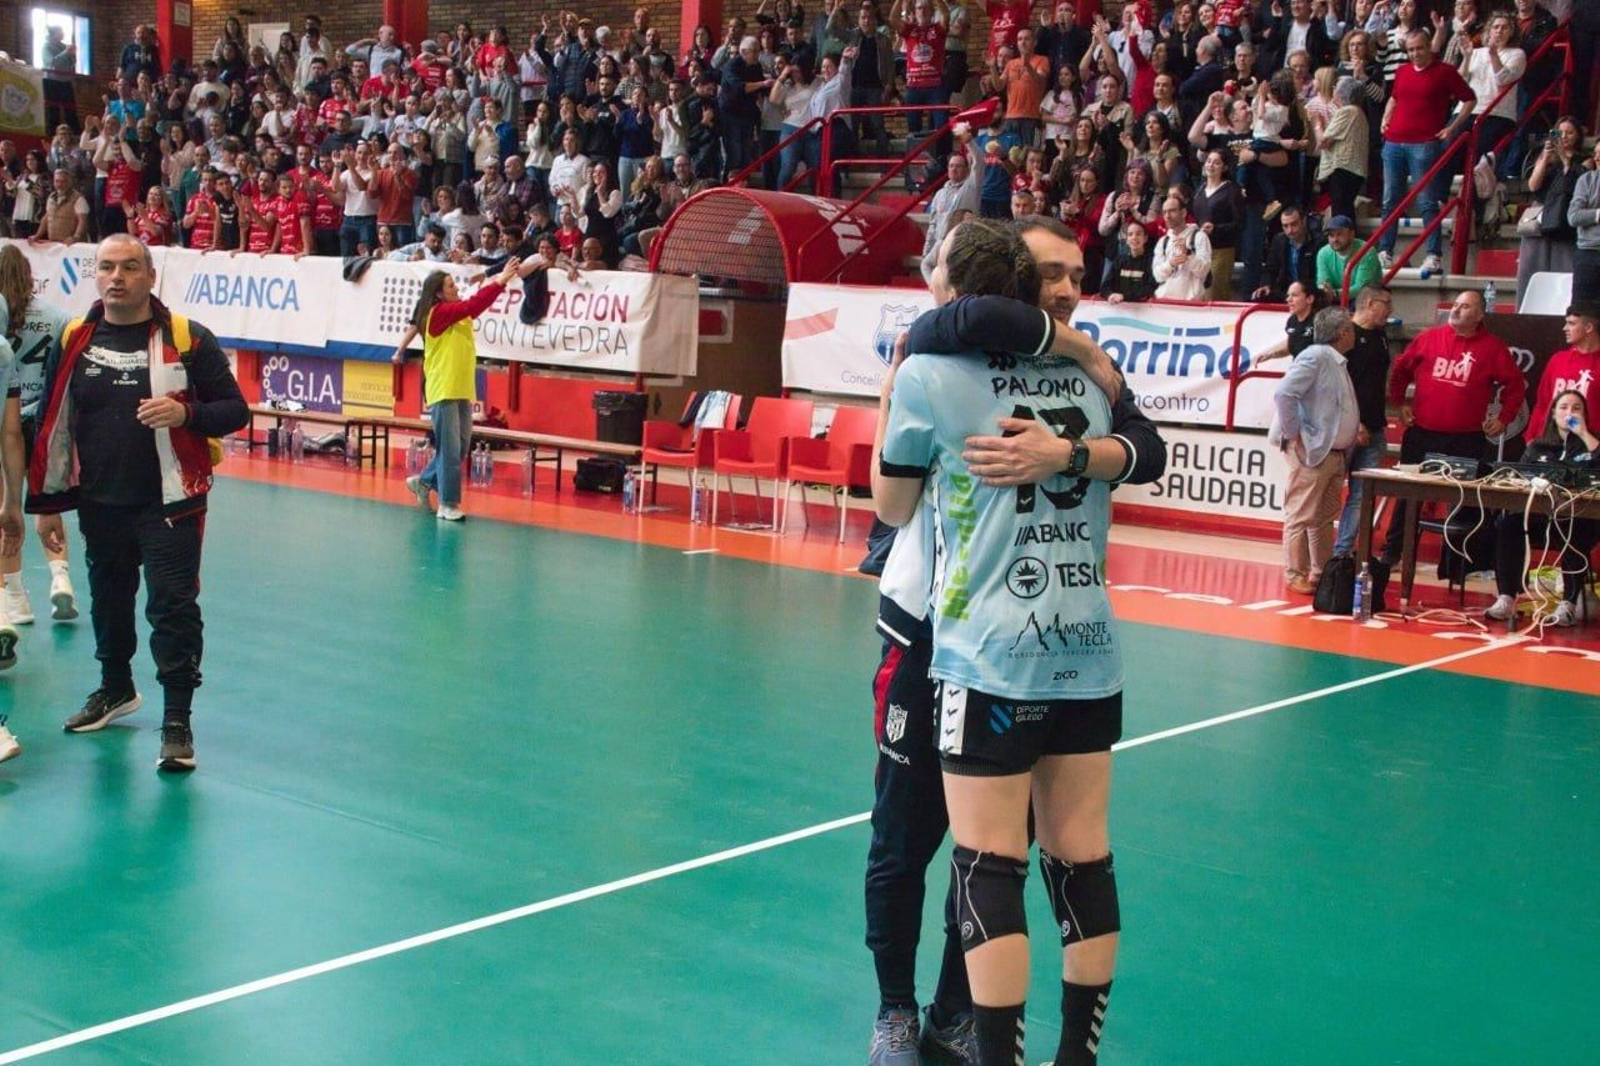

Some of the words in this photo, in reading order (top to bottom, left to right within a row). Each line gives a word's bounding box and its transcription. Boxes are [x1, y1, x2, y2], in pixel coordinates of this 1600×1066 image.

[287, 369, 341, 405] G.I.A.
[991, 376, 1085, 399] PALOMO
[1163, 441, 1265, 476] ALICIA
[1150, 473, 1282, 511] SAUDABL
[1064, 622, 1107, 635] MONTE
[1079, 634, 1112, 647] TECLA
